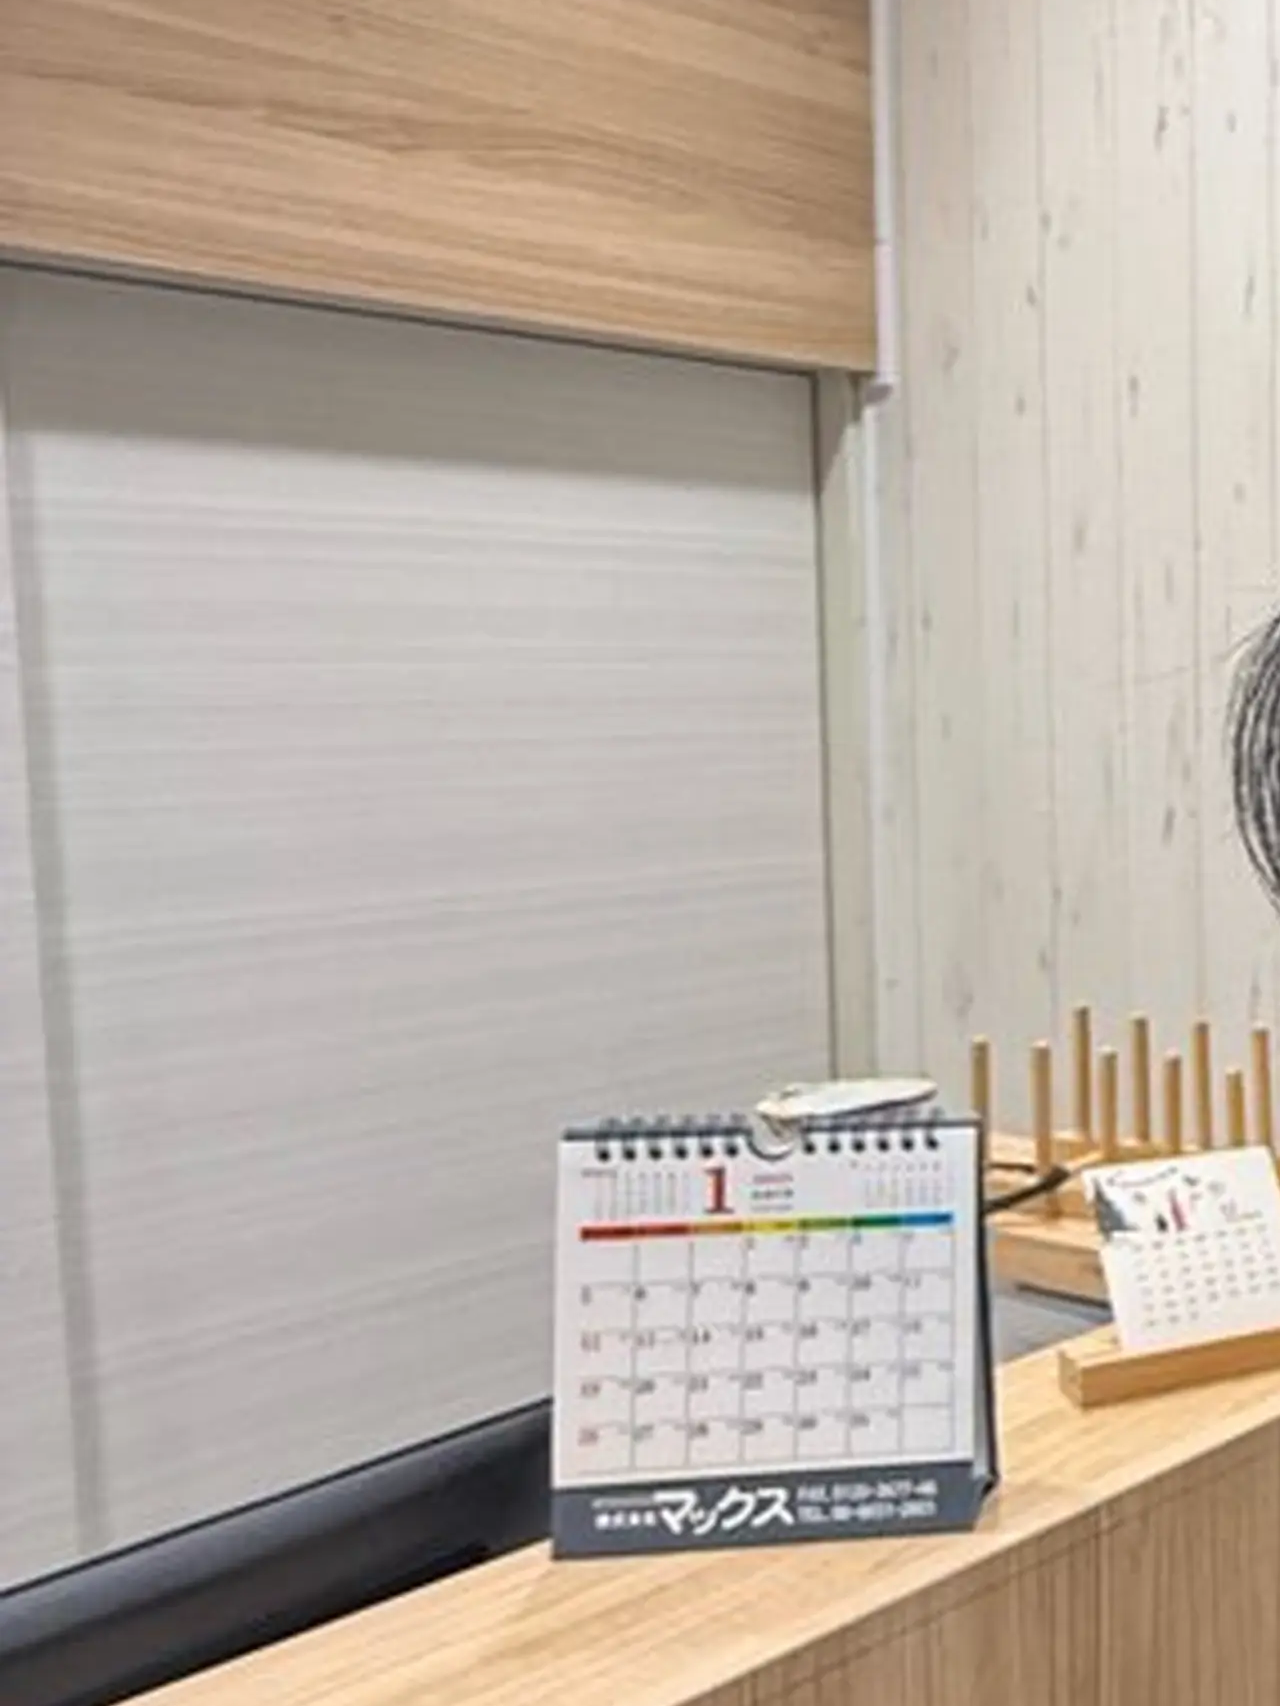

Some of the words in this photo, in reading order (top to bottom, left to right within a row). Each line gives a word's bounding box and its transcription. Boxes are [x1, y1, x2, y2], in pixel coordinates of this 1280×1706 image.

[704, 1167, 733, 1214] 1
[652, 1485, 795, 1535] マックス
